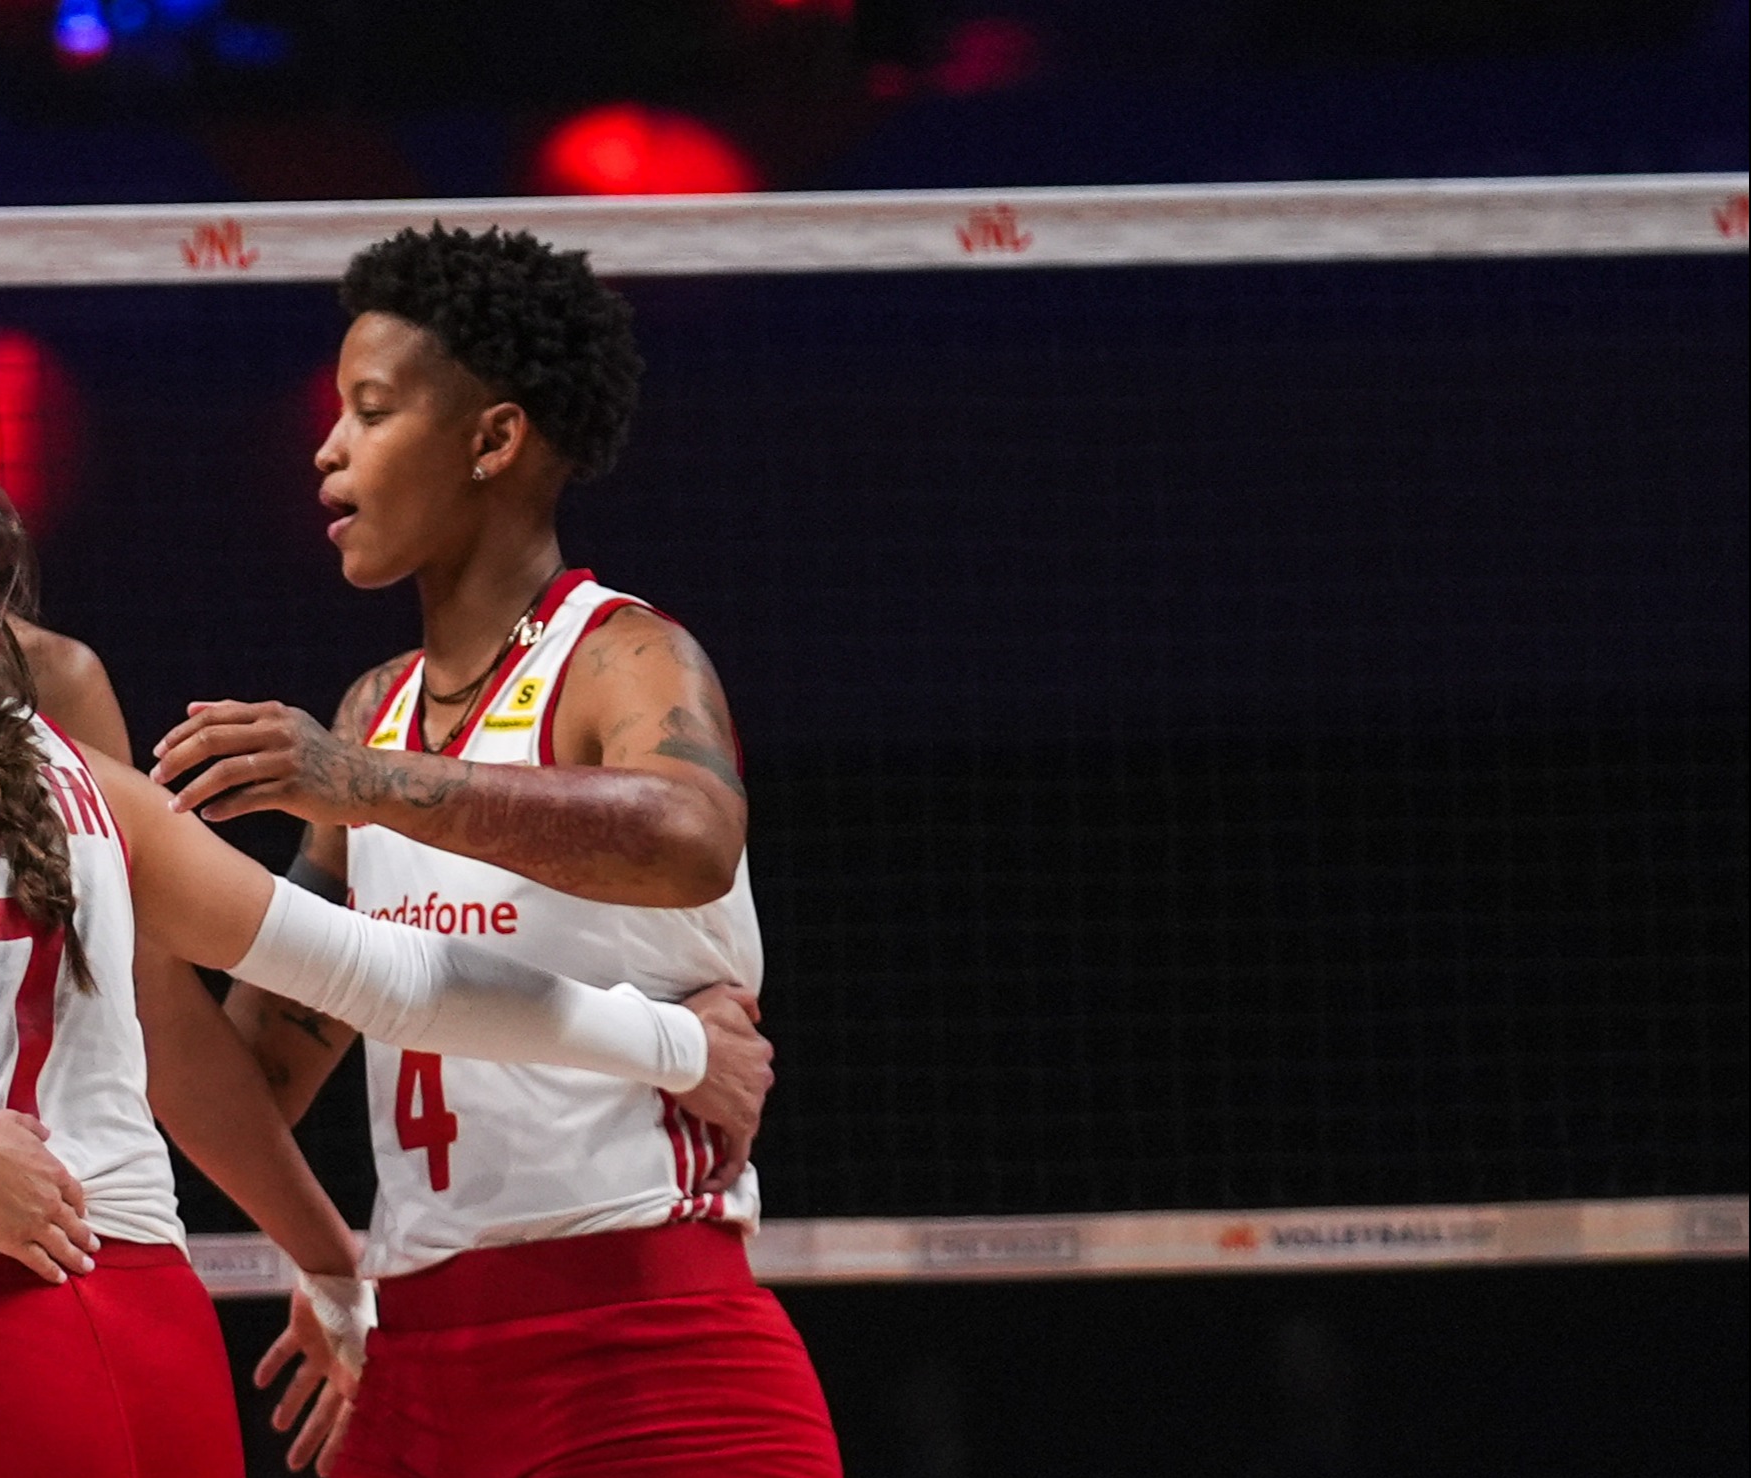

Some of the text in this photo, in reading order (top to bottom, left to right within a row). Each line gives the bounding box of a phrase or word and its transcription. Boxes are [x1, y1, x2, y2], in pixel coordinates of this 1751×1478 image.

[182, 219, 259, 270] VNL
[957, 206, 1032, 252] VNL
[517, 684, 535, 704] S
[396, 1051, 458, 1192] 4
